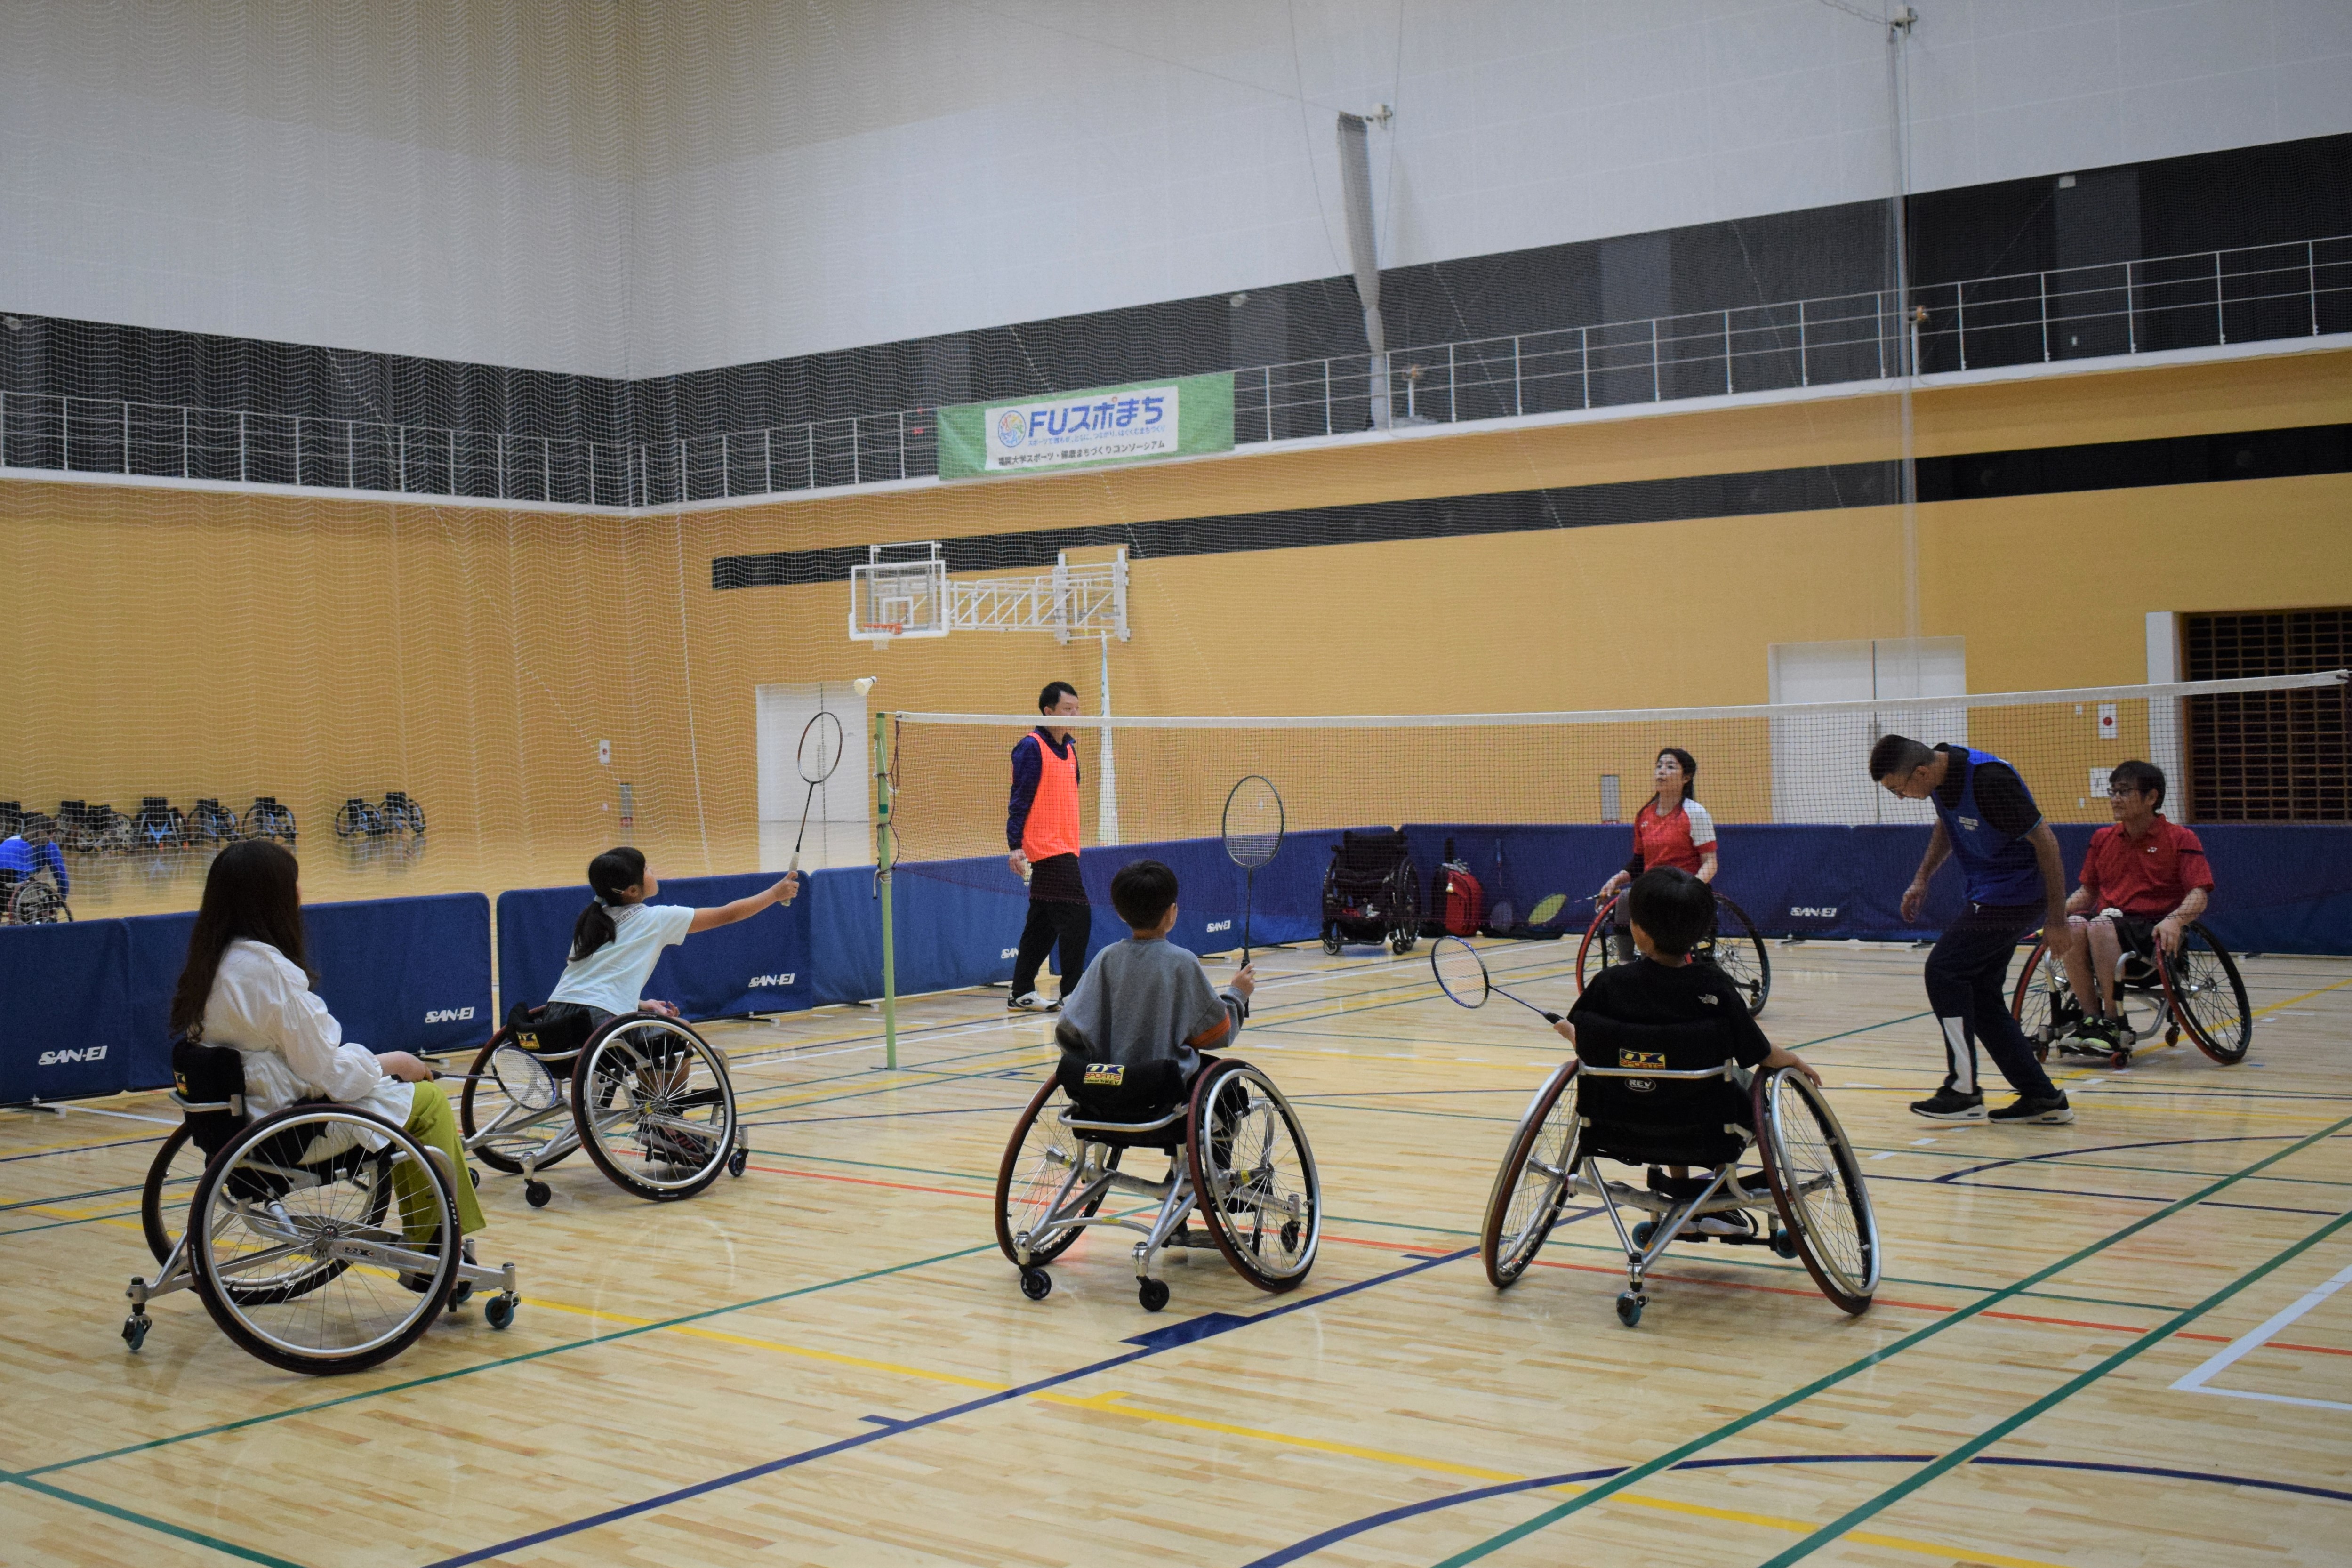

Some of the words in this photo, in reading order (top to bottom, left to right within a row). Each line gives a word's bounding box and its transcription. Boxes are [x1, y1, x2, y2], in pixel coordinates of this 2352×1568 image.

[1028, 396, 1165, 438] FUスポまち
[1001, 948, 1019, 959] SAN
[748, 973, 795, 988] SAN-EI
[425, 1006, 475, 1023] SAN-EI
[38, 1045, 108, 1065] SAN-EI
[1085, 1073, 1121, 1081] SPORTS
[1629, 1079, 1652, 1087] REV
